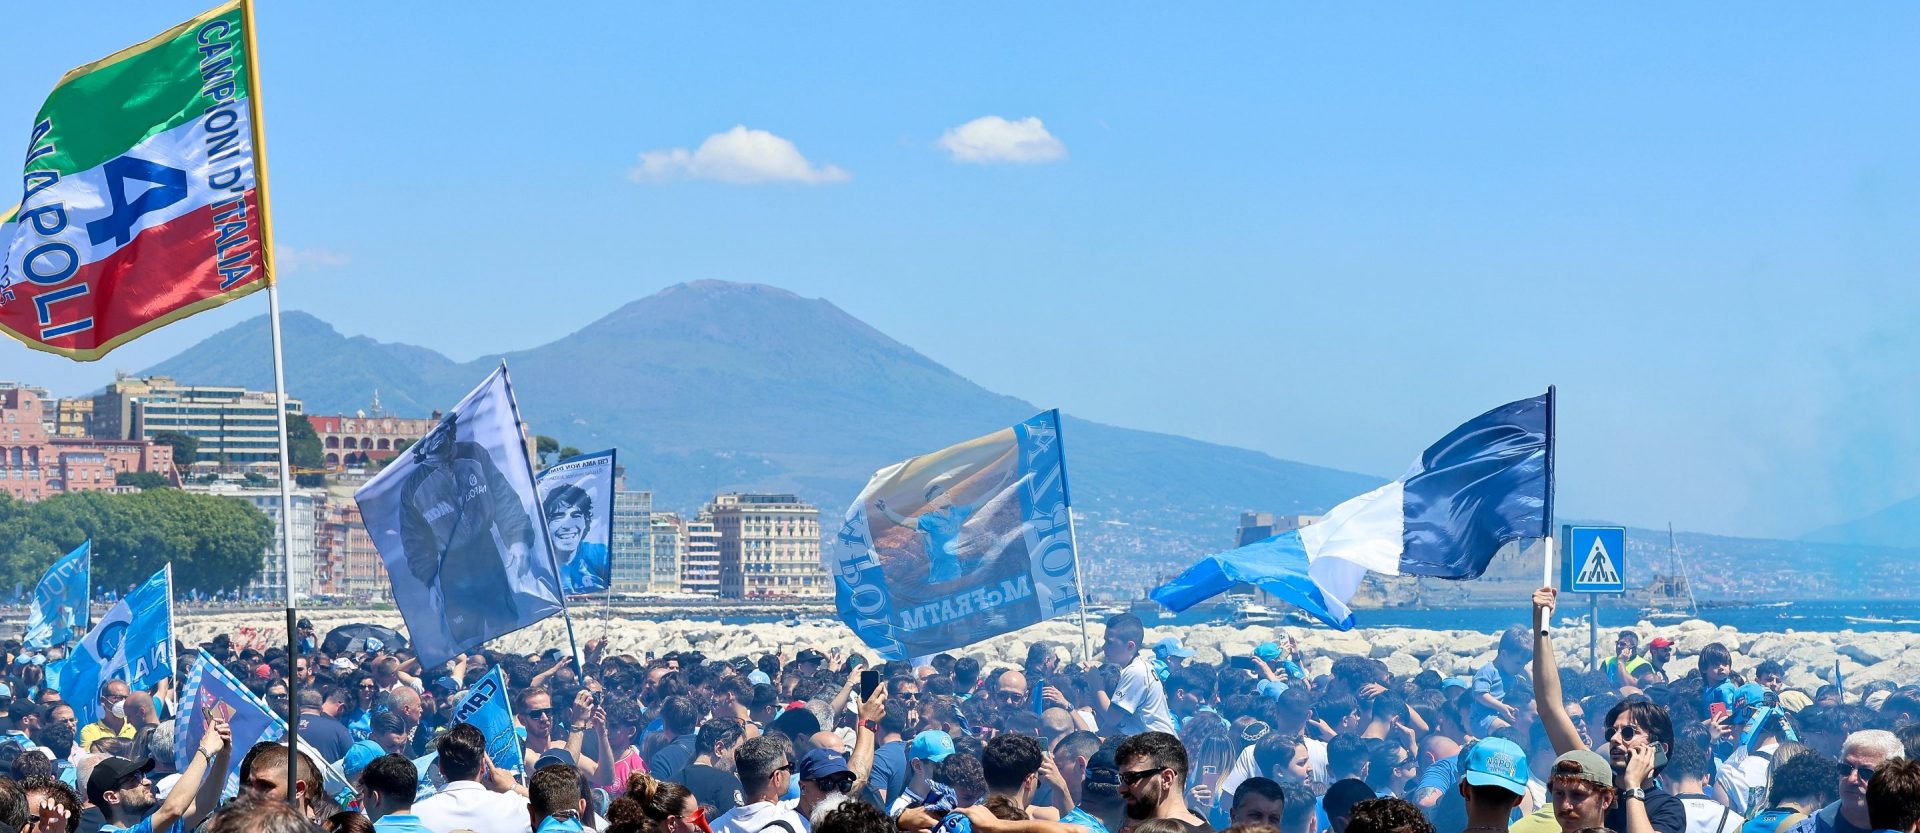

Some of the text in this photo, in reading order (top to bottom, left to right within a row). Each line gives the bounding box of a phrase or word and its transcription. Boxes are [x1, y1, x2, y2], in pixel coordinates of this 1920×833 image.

[19, 118, 95, 341] NAPOLI
[86, 155, 188, 247] 4
[198, 19, 253, 290] CAMPIONI D'ITALIA
